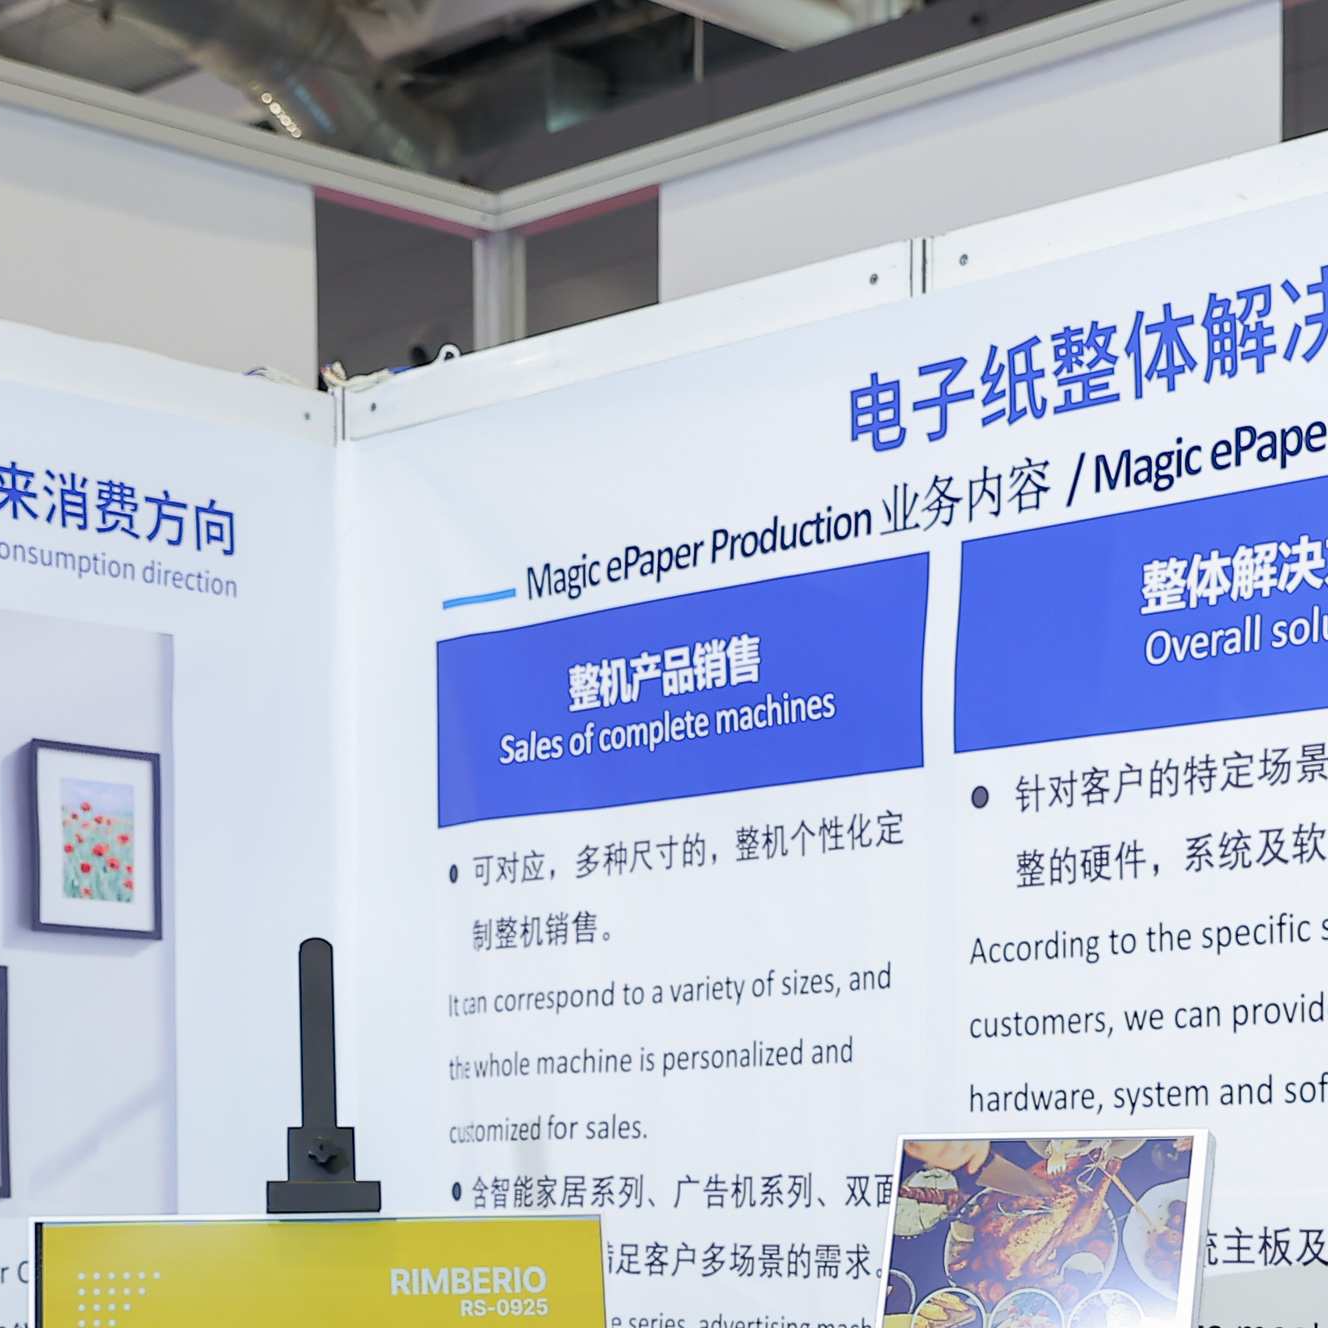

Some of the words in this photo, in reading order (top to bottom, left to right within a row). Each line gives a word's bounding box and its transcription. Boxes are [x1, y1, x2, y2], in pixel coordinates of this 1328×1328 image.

[527, 555, 600, 599] Magic
[606, 535, 703, 583] ePaper
[711, 503, 871, 565] Production
[880, 457, 1051, 537] 业务内容
[1094, 439, 1202, 495] Magic
[142, 560, 237, 598] direction
[1145, 611, 1263, 667] Overall
[568, 634, 760, 713] 整机产品销售
[500, 726, 562, 766] Sales
[569, 722, 594, 757] of
[598, 709, 709, 753] complete
[715, 690, 835, 737] machines
[472, 810, 904, 886] 可对应，多种尺寸的，整机个性化定
[472, 910, 611, 951] 制整机销售。
[971, 932, 1100, 965] According
[1109, 925, 1136, 955] to
[1146, 920, 1192, 953] the
[1201, 911, 1311, 956] specific
[462, 993, 487, 1016] can
[494, 981, 615, 1015] correspond
[623, 981, 644, 1007] to
[652, 985, 664, 1005] a
[670, 974, 744, 1007] variety
[752, 969, 774, 998] of
[782, 968, 840, 998] sizes,
[849, 962, 892, 991] and
[969, 1005, 1113, 1039] customers,
[1124, 1004, 1164, 1032] we
[1174, 1002, 1221, 1029] can
[473, 1049, 530, 1078] whole
[537, 1046, 632, 1075] machine
[639, 1045, 655, 1072] is
[663, 1037, 803, 1076] personalized
[811, 1036, 853, 1064] and
[969, 1081, 1104, 1116] hardware,
[1113, 1078, 1209, 1116] system
[1219, 1075, 1272, 1106] and
[449, 1115, 541, 1144] customized
[547, 1115, 578, 1141] for
[586, 1113, 647, 1140] sales.
[390, 1267, 546, 1295] RIMBERIO
[460, 1299, 548, 1316] RS-0925
